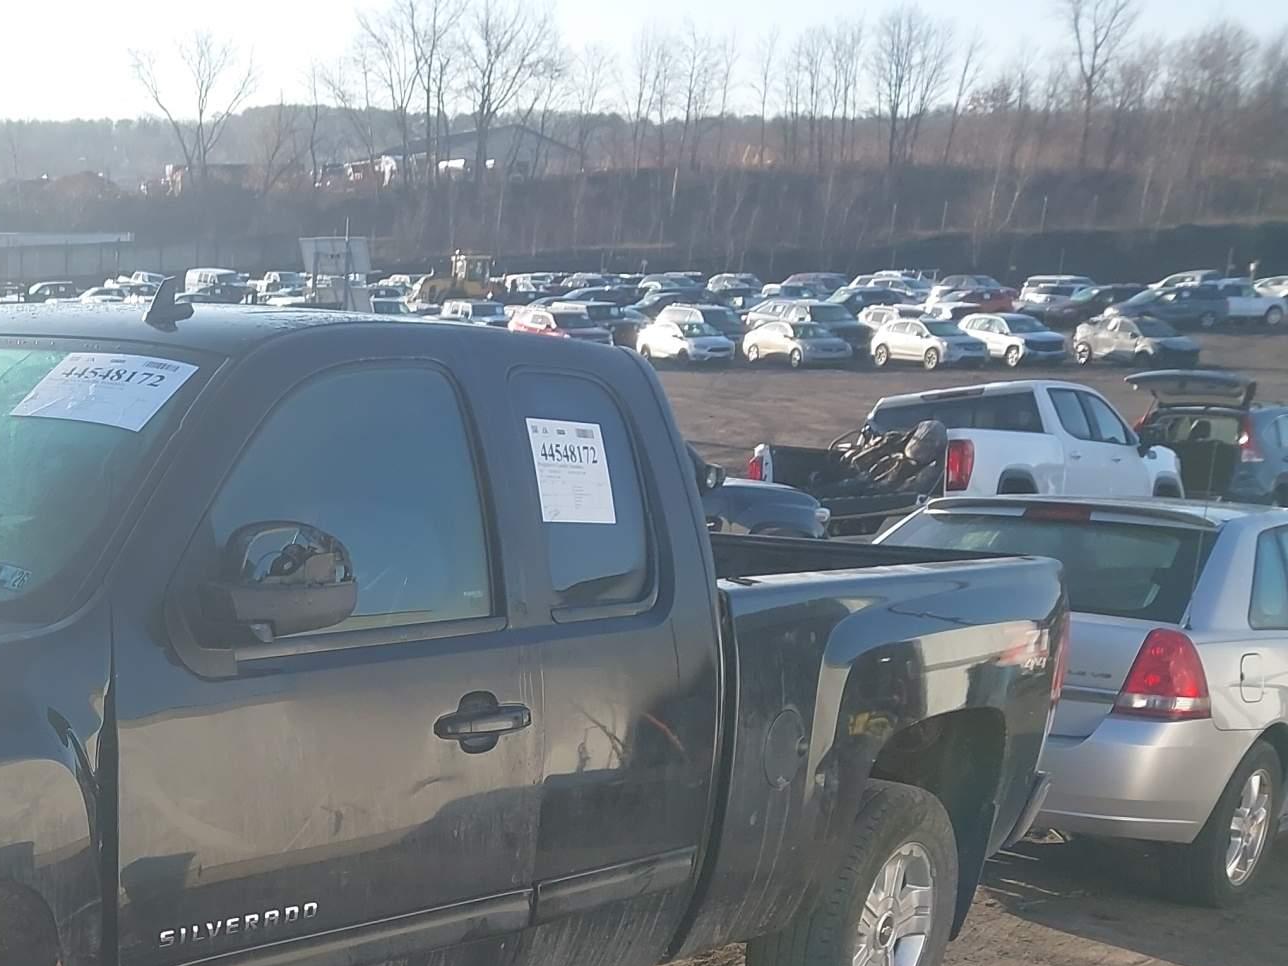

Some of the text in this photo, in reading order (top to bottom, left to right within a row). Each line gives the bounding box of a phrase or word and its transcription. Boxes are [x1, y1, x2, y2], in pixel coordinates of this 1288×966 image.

[62, 365, 166, 388] 44548172
[540, 442, 598, 464] 44548172
[158, 901, 319, 948] SILVERADO
